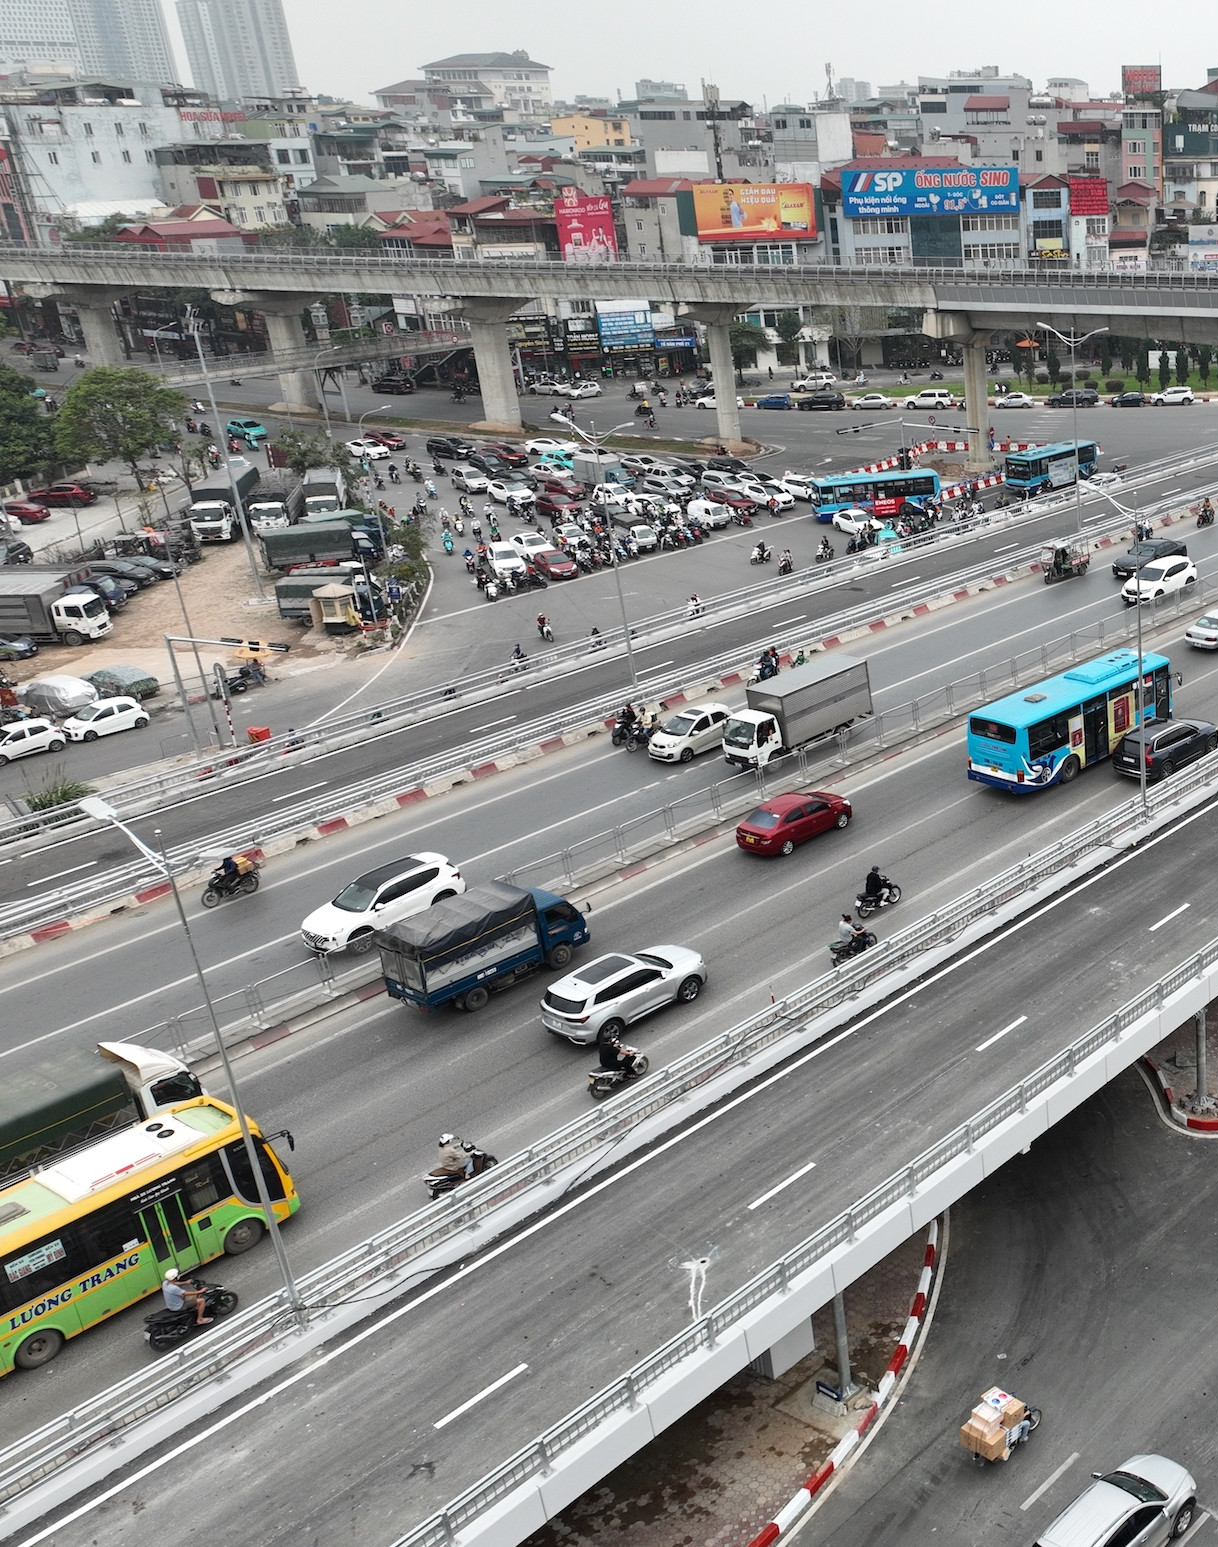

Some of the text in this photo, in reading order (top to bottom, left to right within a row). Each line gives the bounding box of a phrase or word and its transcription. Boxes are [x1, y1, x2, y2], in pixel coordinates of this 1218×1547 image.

[1126, 69, 1158, 83] HOTEL
[874, 172, 903, 192] SP
[915, 169, 1010, 188] ỐNG NƯỚC SINO
[740, 187, 760, 195] GIẢM
[741, 196, 760, 205] HIỆU
[849, 194, 907, 206] Phụ kiện nối ống
[858, 206, 880, 214] thông
[9, 1252, 140, 1331] LƯƠNG TRANG
